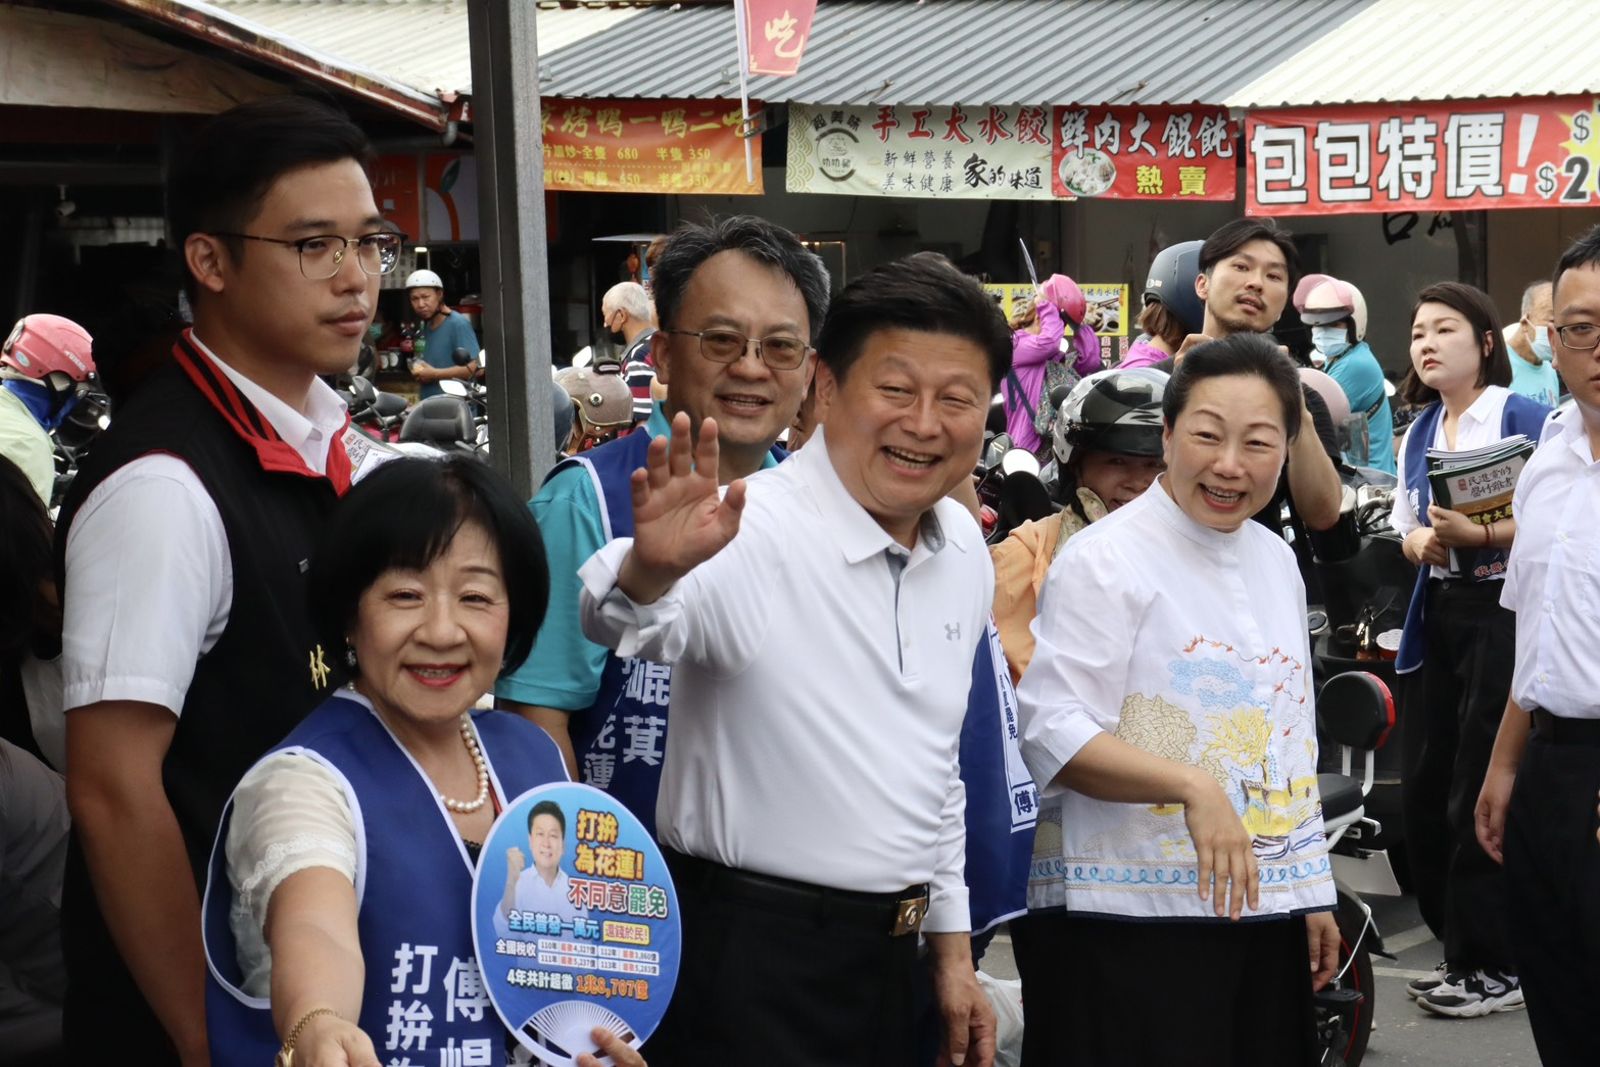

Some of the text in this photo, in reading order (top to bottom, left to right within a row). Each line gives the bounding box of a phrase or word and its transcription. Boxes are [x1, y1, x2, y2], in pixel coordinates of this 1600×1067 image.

[764, 9, 804, 58] 吃
[871, 104, 1051, 144] 手工大水餃
[1060, 109, 1233, 158] 鮮肉大餛飩
[617, 147, 638, 160] 680
[689, 148, 710, 160] 350
[884, 150, 956, 170] 新鮮營養
[963, 152, 1043, 189] 家的味道
[1251, 112, 1541, 204] 包包特價!
[882, 172, 954, 193] 美味健康
[1136, 166, 1207, 195] 熱賣
[309, 643, 331, 690] 林
[1014, 789, 1039, 816] 傅
[568, 878, 668, 918] 不同意罷免
[386, 942, 438, 1067] 打拚
